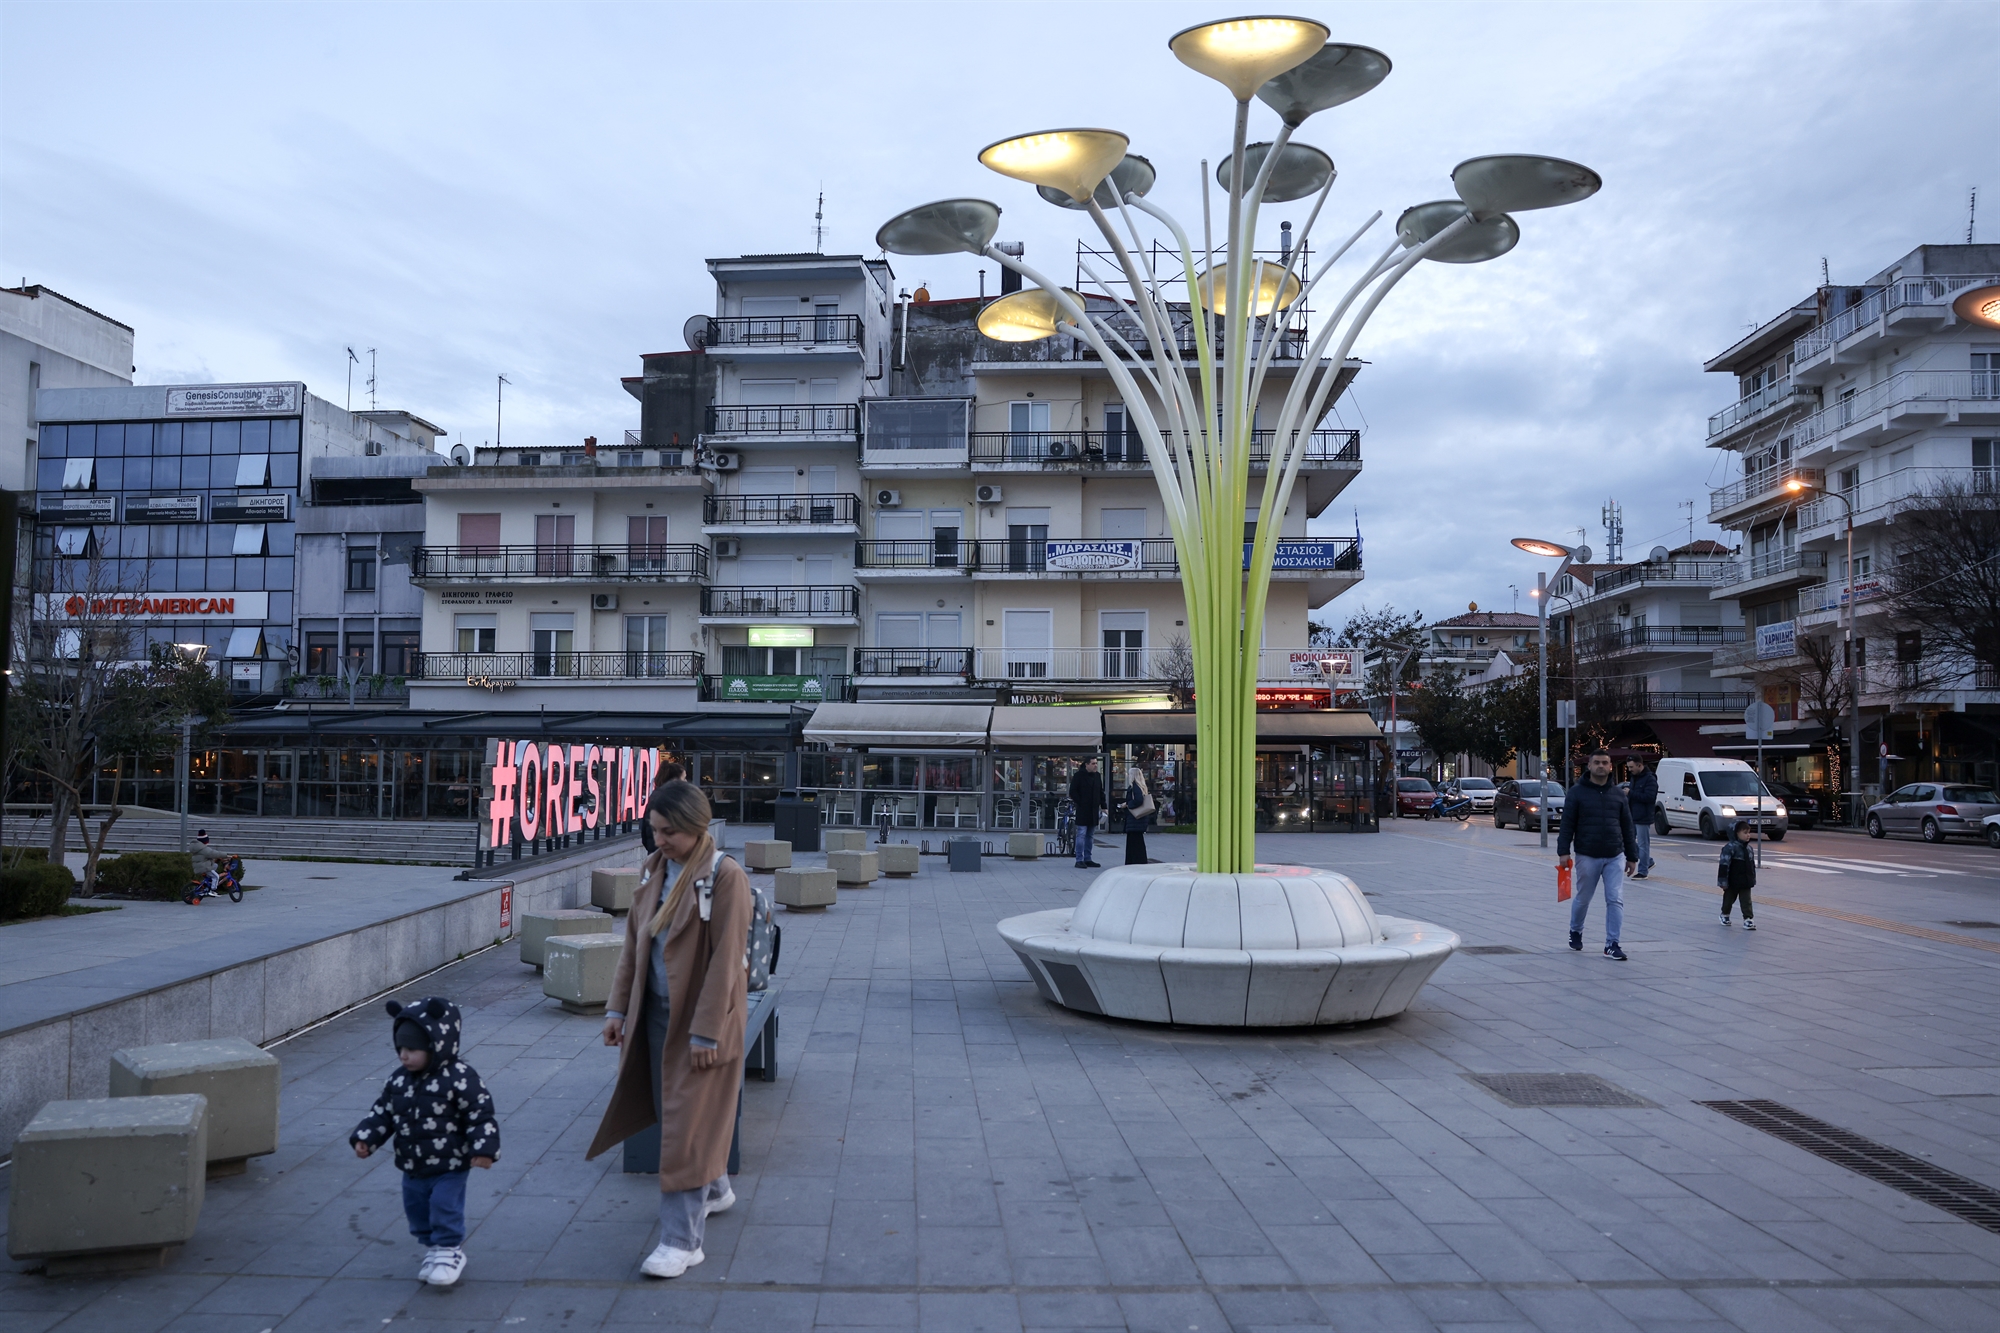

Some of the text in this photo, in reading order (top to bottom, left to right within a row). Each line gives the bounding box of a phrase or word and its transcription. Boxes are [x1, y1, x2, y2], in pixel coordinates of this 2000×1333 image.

[185, 389, 262, 401] GenesisConsulting
[250, 498, 284, 506] ΔΙΚΗΓΟΡΟΣ
[1055, 555, 1125, 566] ΒΙΒΛΙΟΠΩΛΕΙΟ
[91, 598, 234, 614] INTERAMERICAN
[1289, 653, 1352, 663] ΕΝΟΙΚΙΑΖΕΤΑΙ
[1011, 694, 1064, 705] ΜΑΡΑΣΛΗΣ
[490, 740, 660, 848] #ORESTIAD
